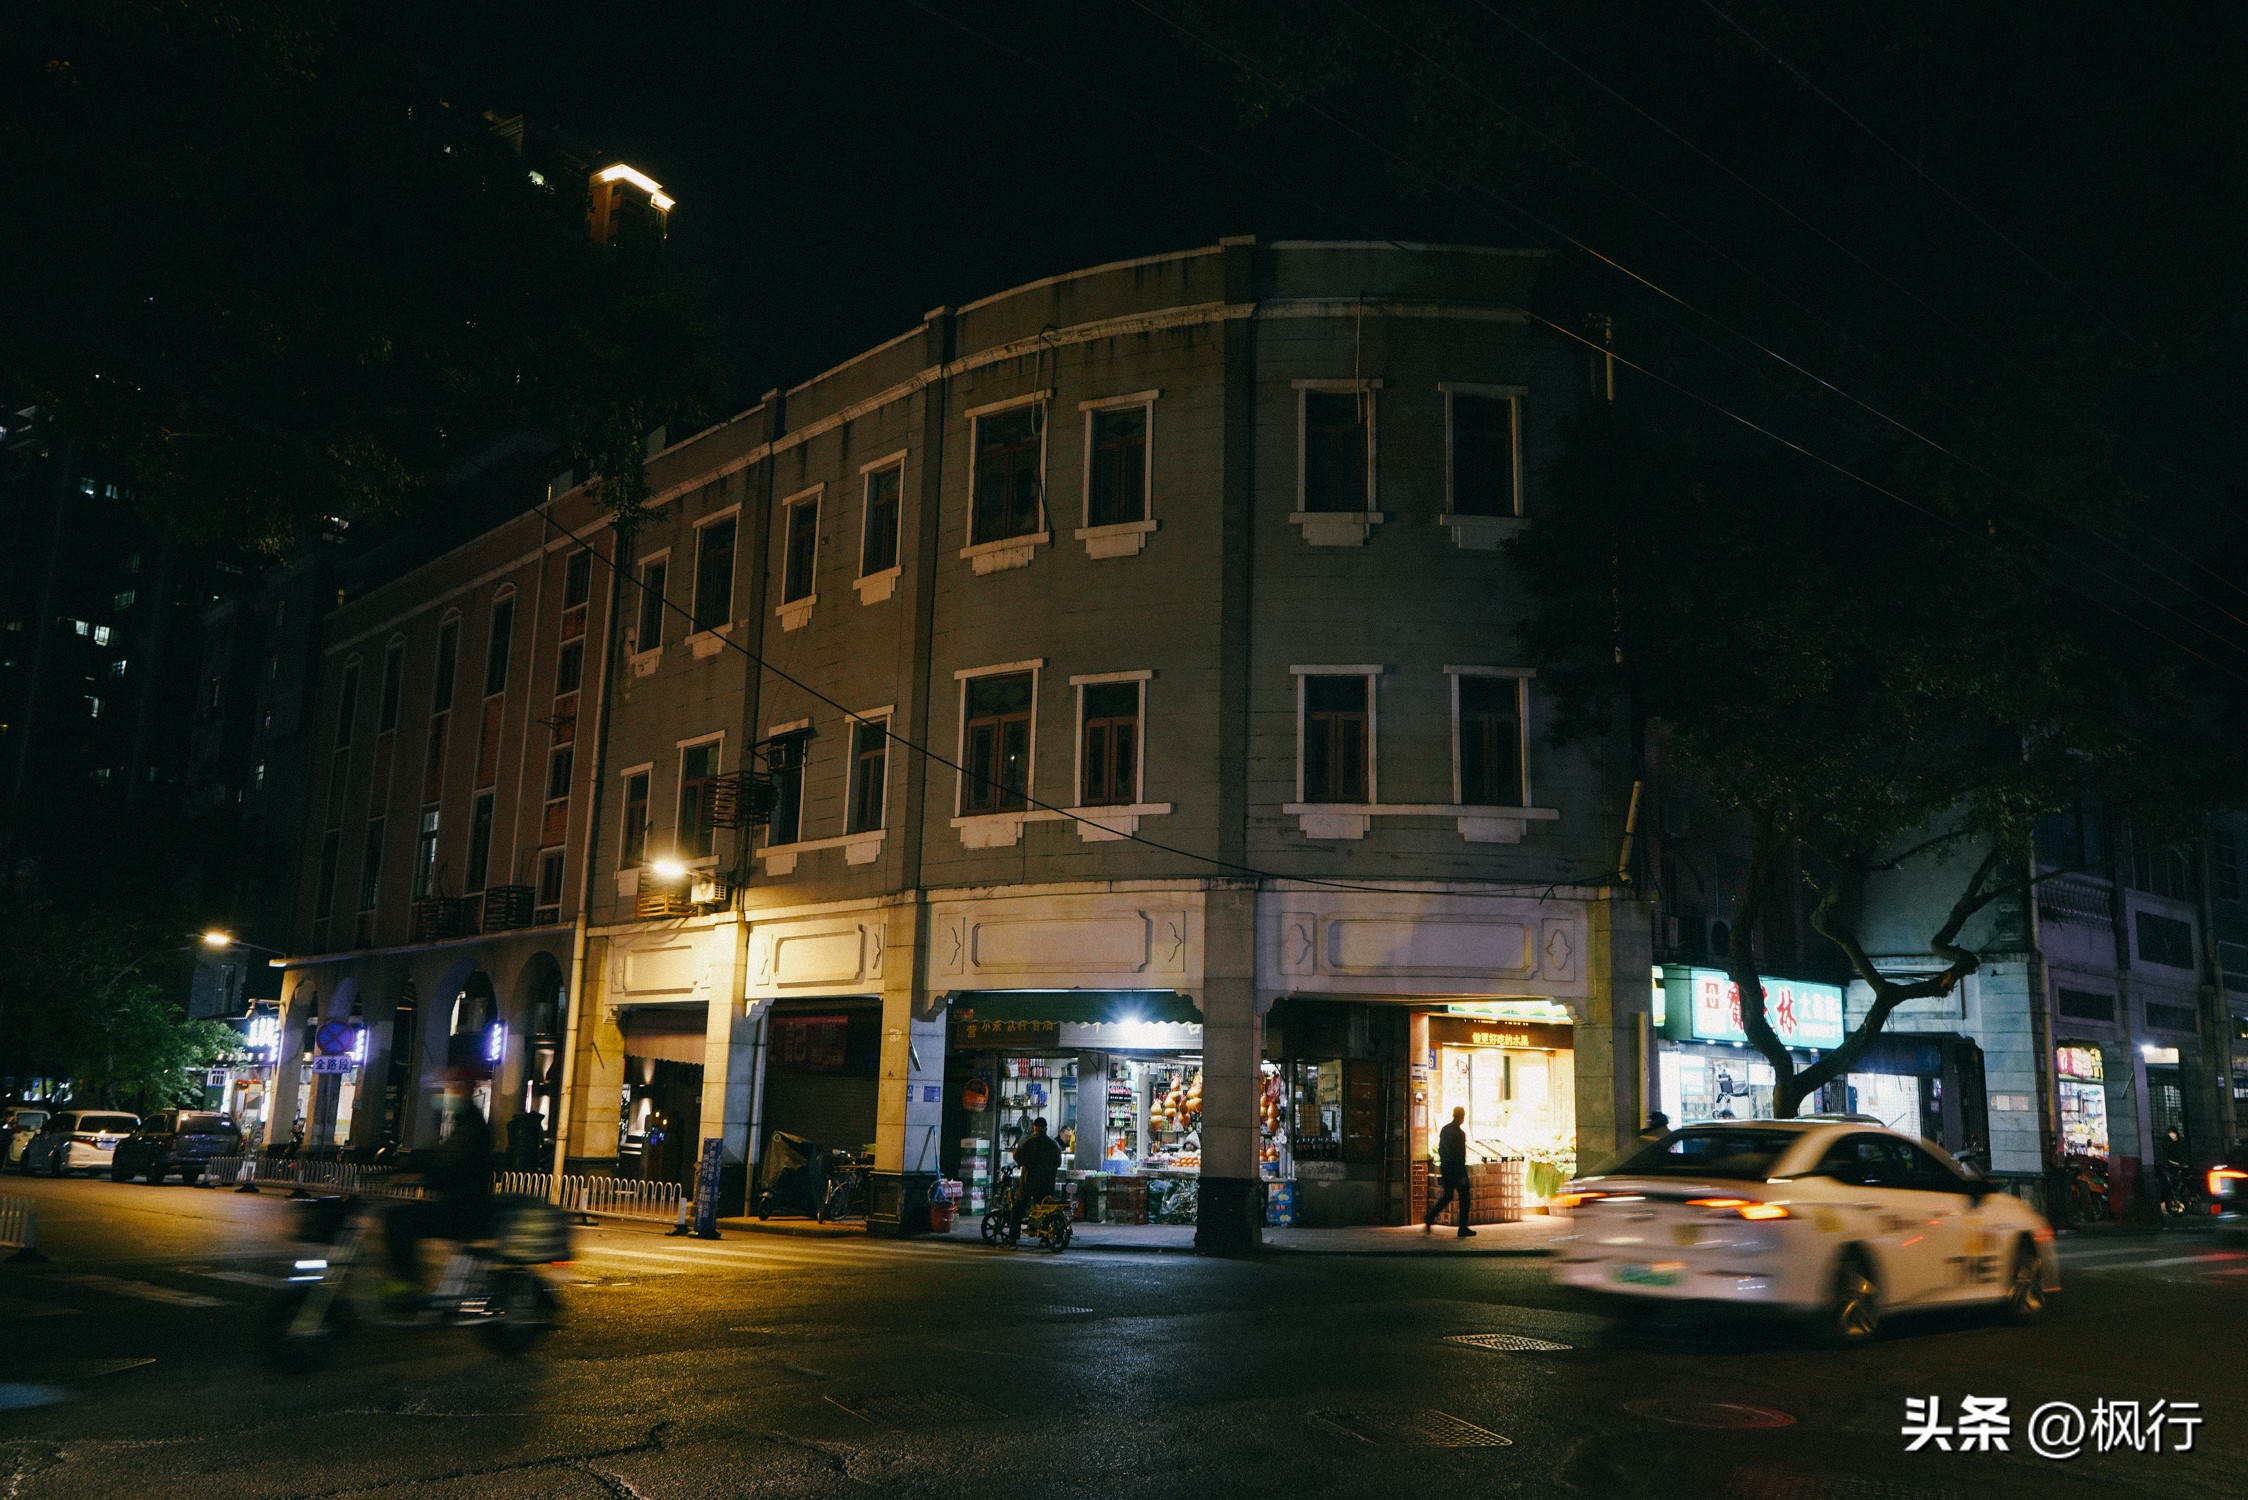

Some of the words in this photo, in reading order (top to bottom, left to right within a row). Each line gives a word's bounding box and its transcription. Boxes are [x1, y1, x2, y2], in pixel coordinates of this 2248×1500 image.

[1472, 1032, 1529, 1047] 做更好吃的水果
[315, 1059, 350, 1071] 全路段
